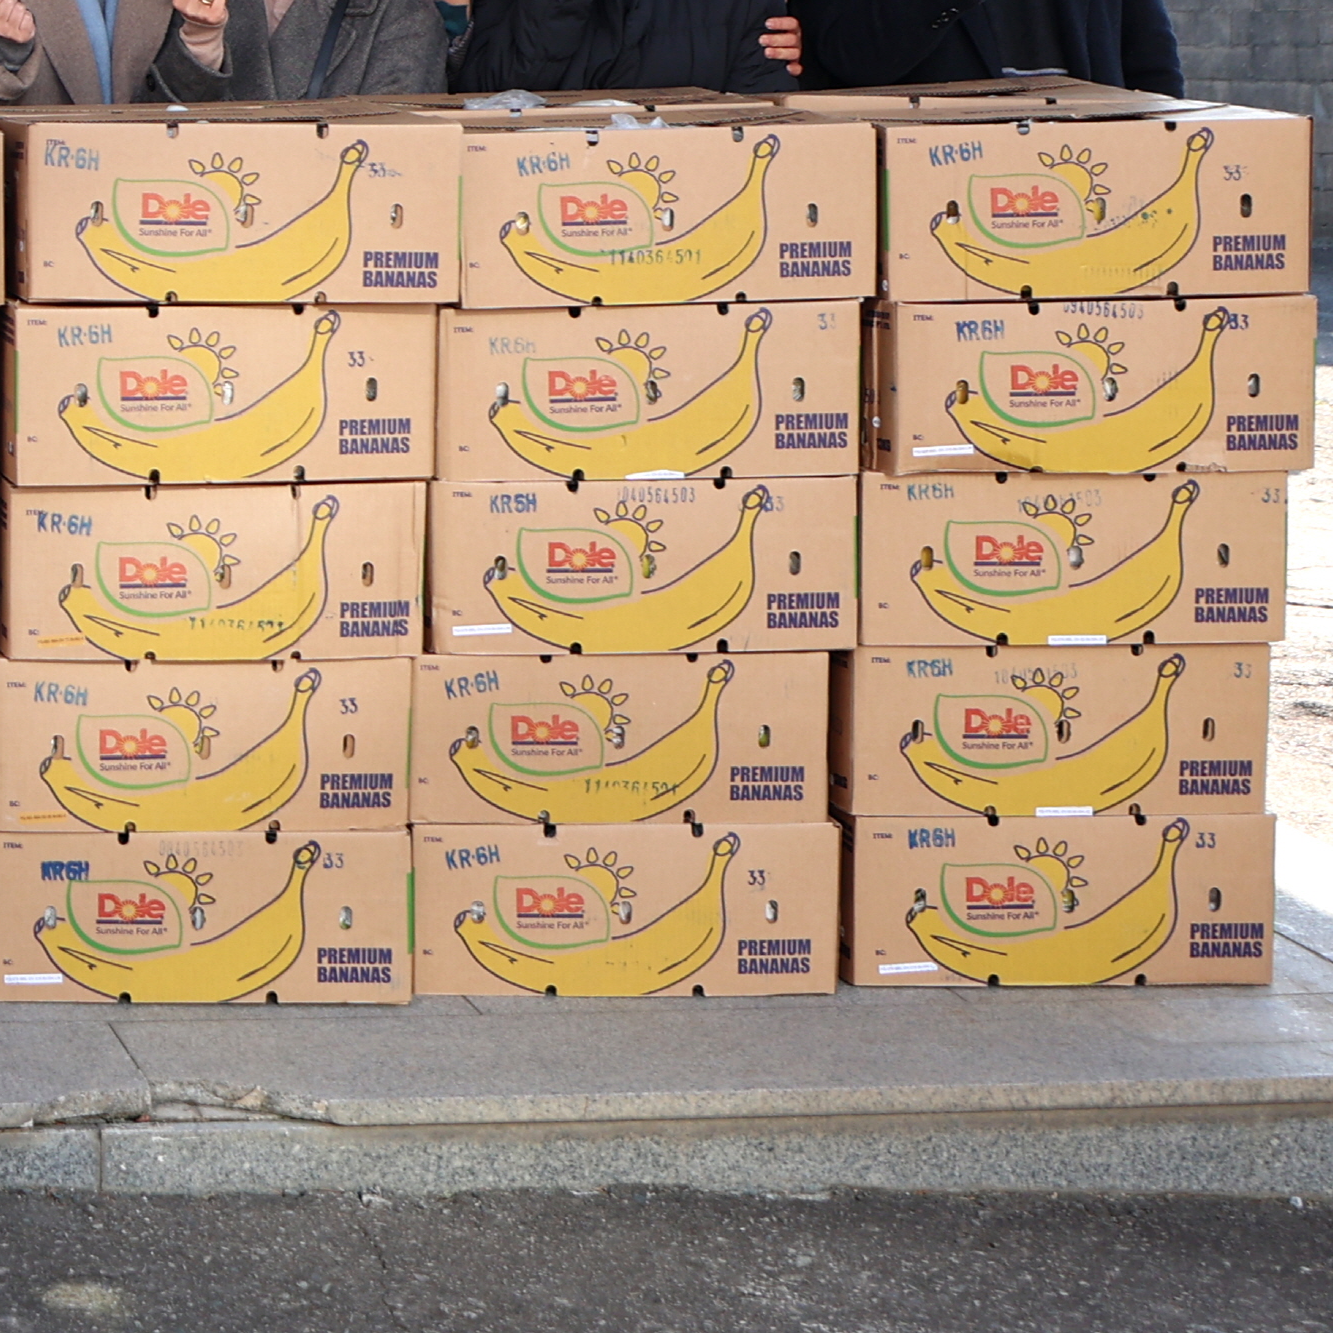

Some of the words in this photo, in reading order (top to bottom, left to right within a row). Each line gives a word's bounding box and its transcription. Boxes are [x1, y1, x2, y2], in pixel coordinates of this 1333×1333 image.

[143, 194, 210, 220] Dole
[561, 195, 627, 222] Dole
[991, 187, 1059, 213] Dole
[991, 219, 1029, 229] Sunshine
[1031, 220, 1045, 228] For
[780, 240, 852, 259] PREMIUM
[1213, 233, 1286, 252] PREMIUM
[363, 249, 439, 271] PREMIUM
[779, 259, 851, 279] BANANAS
[1213, 252, 1285, 271] BANANAS
[361, 268, 437, 290] BANANAS
[348, 351, 365, 367] 33
[121, 370, 187, 397] Dole
[549, 371, 617, 399] Dole
[1012, 365, 1078, 392] Dole
[339, 417, 411, 436] PREMIUM
[775, 413, 848, 430] PREMIUM
[1227, 413, 1298, 433] PREMIUM
[339, 436, 410, 456] BANANAS
[775, 431, 848, 449] BANANAS
[1227, 432, 1297, 452] BANANAS
[549, 543, 616, 569] Dole
[976, 536, 1044, 562] Dole
[120, 558, 186, 584] Dole
[545, 574, 583, 584] Sunshine
[585, 575, 600, 583] For
[767, 591, 840, 611] PREMIUM
[1195, 585, 1269, 606] PREMIUM
[340, 601, 412, 619] PREMIUM
[766, 610, 839, 630] BANANAS
[1194, 604, 1268, 625] BANANAS
[339, 619, 411, 638] BANANAS
[340, 698, 358, 715] 33
[512, 716, 579, 741] Dole
[965, 709, 1031, 735] Dole
[100, 730, 166, 757] Dole
[731, 764, 803, 784] PREMIUM
[1180, 758, 1252, 778] PREMIUM
[320, 773, 392, 790] PREMIUM
[1179, 776, 1251, 797] BANANAS
[320, 791, 392, 809] BANANAS
[730, 783, 802, 803] BANANAS
[748, 870, 765, 885] 33
[967, 877, 1034, 905] Dole
[99, 894, 165, 920] Dole
[517, 888, 584, 915] Dole
[966, 911, 1005, 920] Sunshine
[1006, 911, 1021, 919] For
[1190, 922, 1263, 940] PREMIUM
[318, 945, 391, 966] PREMIUM
[738, 937, 811, 957] PREMIUM
[1190, 940, 1263, 959] BANANAS
[317, 964, 391, 985] BANANAS
[737, 955, 810, 976] BANANAS
